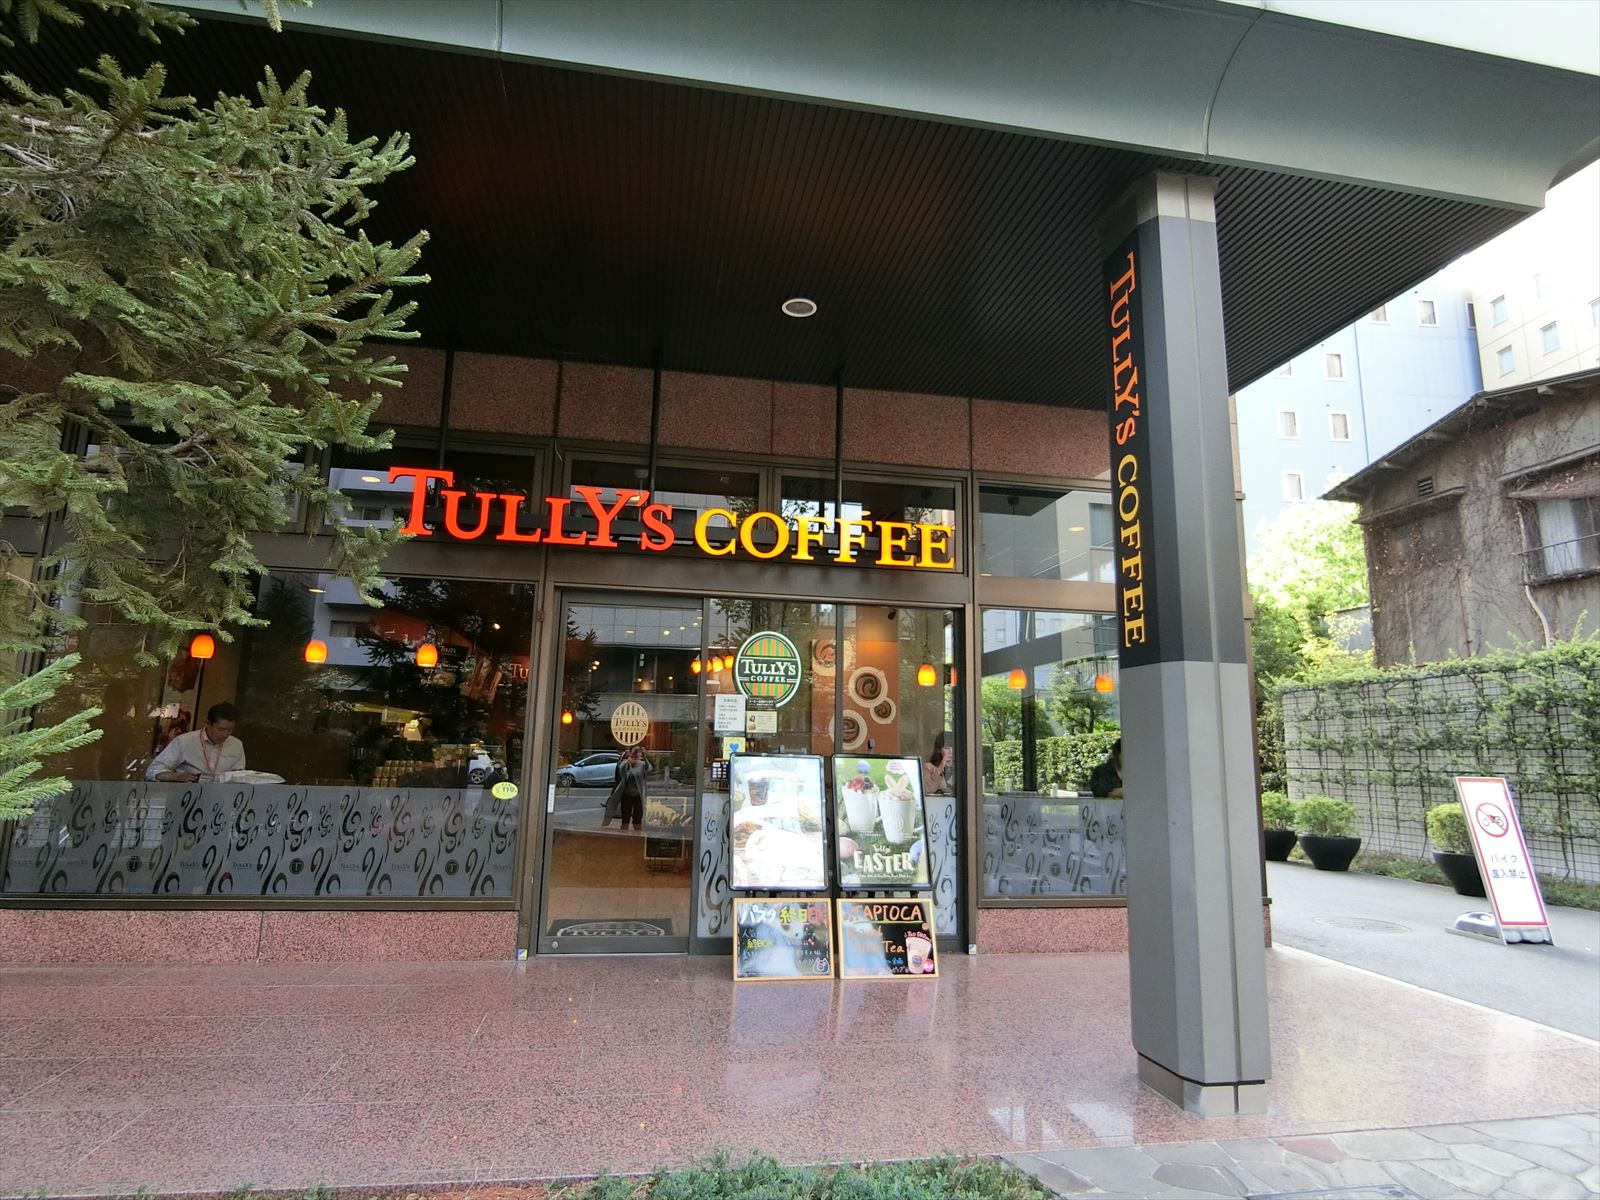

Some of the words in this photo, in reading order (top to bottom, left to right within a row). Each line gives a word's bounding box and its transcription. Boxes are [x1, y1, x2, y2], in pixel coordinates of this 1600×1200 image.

[693, 507, 956, 571] COFFEE
[1117, 454, 1146, 648] COFFEE
[750, 675, 786, 683] COFFEE
[853, 849, 916, 874] EASTER
[881, 940, 906, 953] Tea
